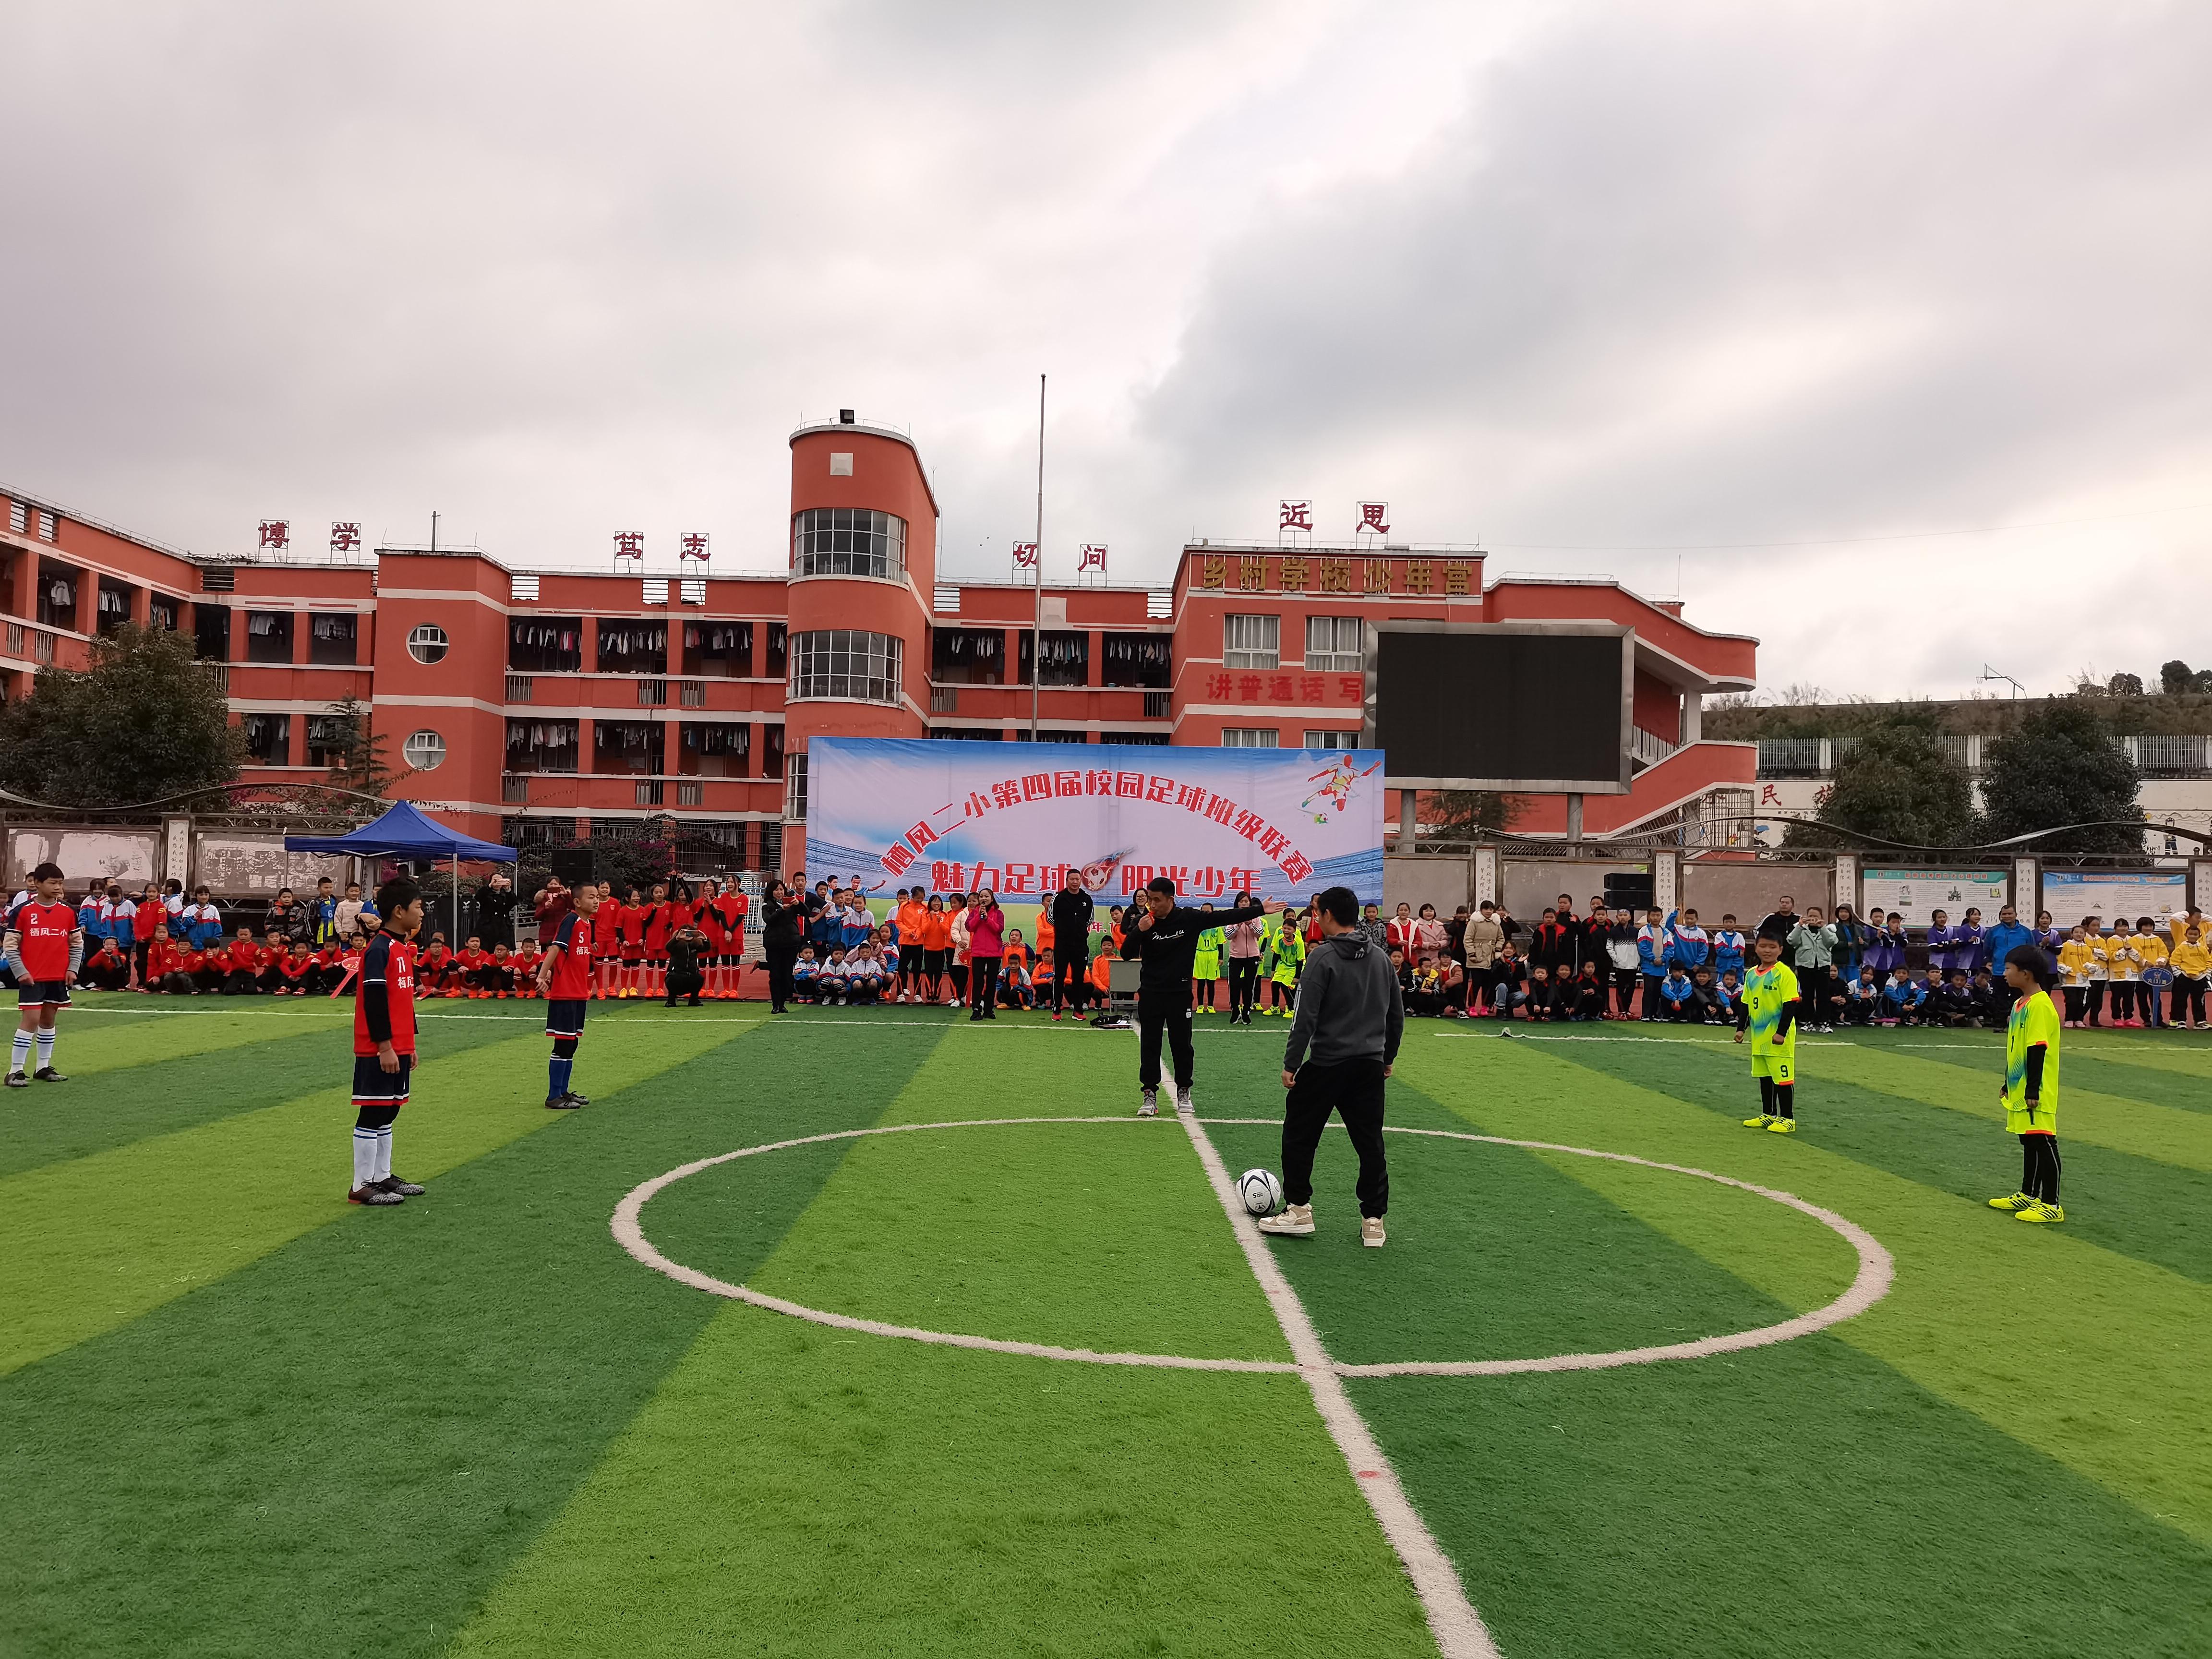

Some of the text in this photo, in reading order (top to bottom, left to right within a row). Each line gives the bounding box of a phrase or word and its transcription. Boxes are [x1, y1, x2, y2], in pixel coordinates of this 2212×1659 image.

[1202, 557, 1472, 594] 乡村学校少年宫
[1206, 674, 1324, 702] 讲普通话
[880, 769, 1314, 885] 栖凤二小第四届校园足球班级联赛
[931, 861, 1262, 898] 魅力足球 阳光少年
[31, 914, 38, 924] 2
[30, 927, 68, 937] 栖凤二小
[578, 931, 584, 943] 5
[397, 956, 406, 973] 11
[1753, 997, 1759, 1010] 9
[2010, 1035, 2015, 1053] 1
[1780, 1065, 1789, 1078] 9
